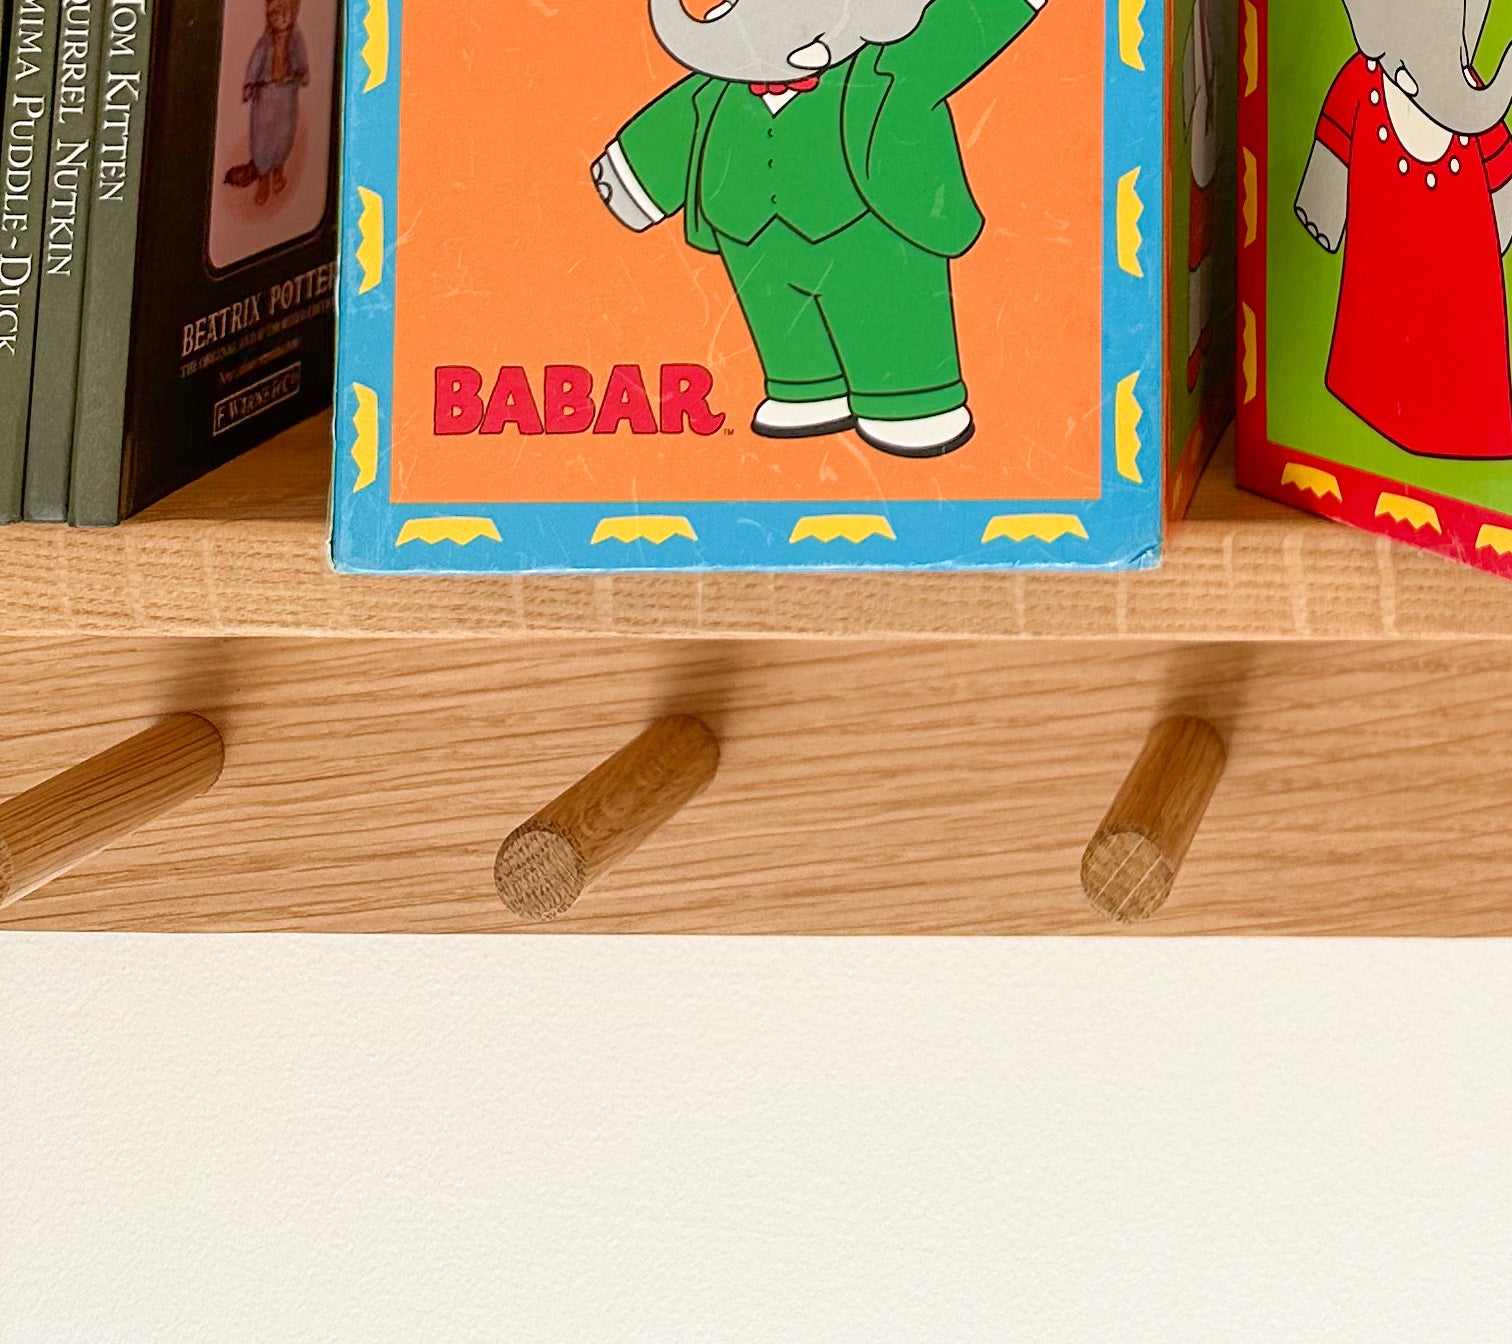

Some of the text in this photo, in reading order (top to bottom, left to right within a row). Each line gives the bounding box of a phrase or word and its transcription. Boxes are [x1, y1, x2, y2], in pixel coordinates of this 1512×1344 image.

[99, 70, 141, 202] KITTEN
[47, 138, 90, 277] NUTKIN
[181, 291, 263, 358] BEATRIX
[433, 363, 727, 436] BABAR
